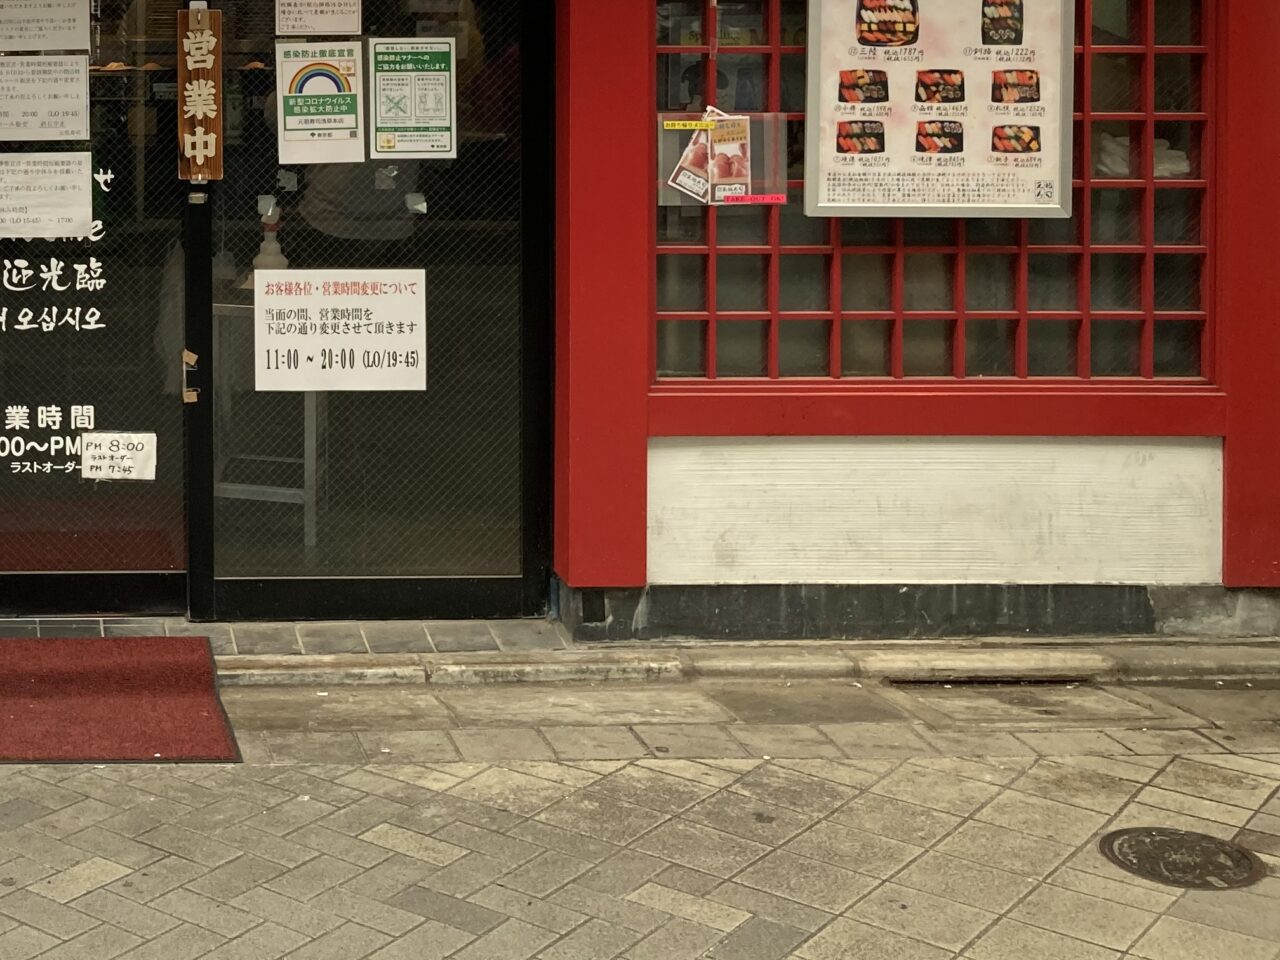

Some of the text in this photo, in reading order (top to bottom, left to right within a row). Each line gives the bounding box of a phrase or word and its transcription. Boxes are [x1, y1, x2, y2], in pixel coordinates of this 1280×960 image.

[283, 49, 354, 58] 感染防止徹底宣言
[183, 29, 217, 166] 営業中
[289, 97, 352, 106] 新型コロナウイルス
[293, 105, 348, 113] 感染拡大防止中
[264, 281, 417, 296] お客様各位・営業時間変更について
[14, 306, 107, 331] 오십시오
[264, 308, 373, 321] 当面の間、営業時間を
[265, 322, 418, 335] 下記の通り変更させて頂きます
[266, 348, 419, 370] 11:00 20:00 (LO/19:45)
[86, 439, 145, 453] PM 8:00
[90, 465, 135, 474] PM 7:45
